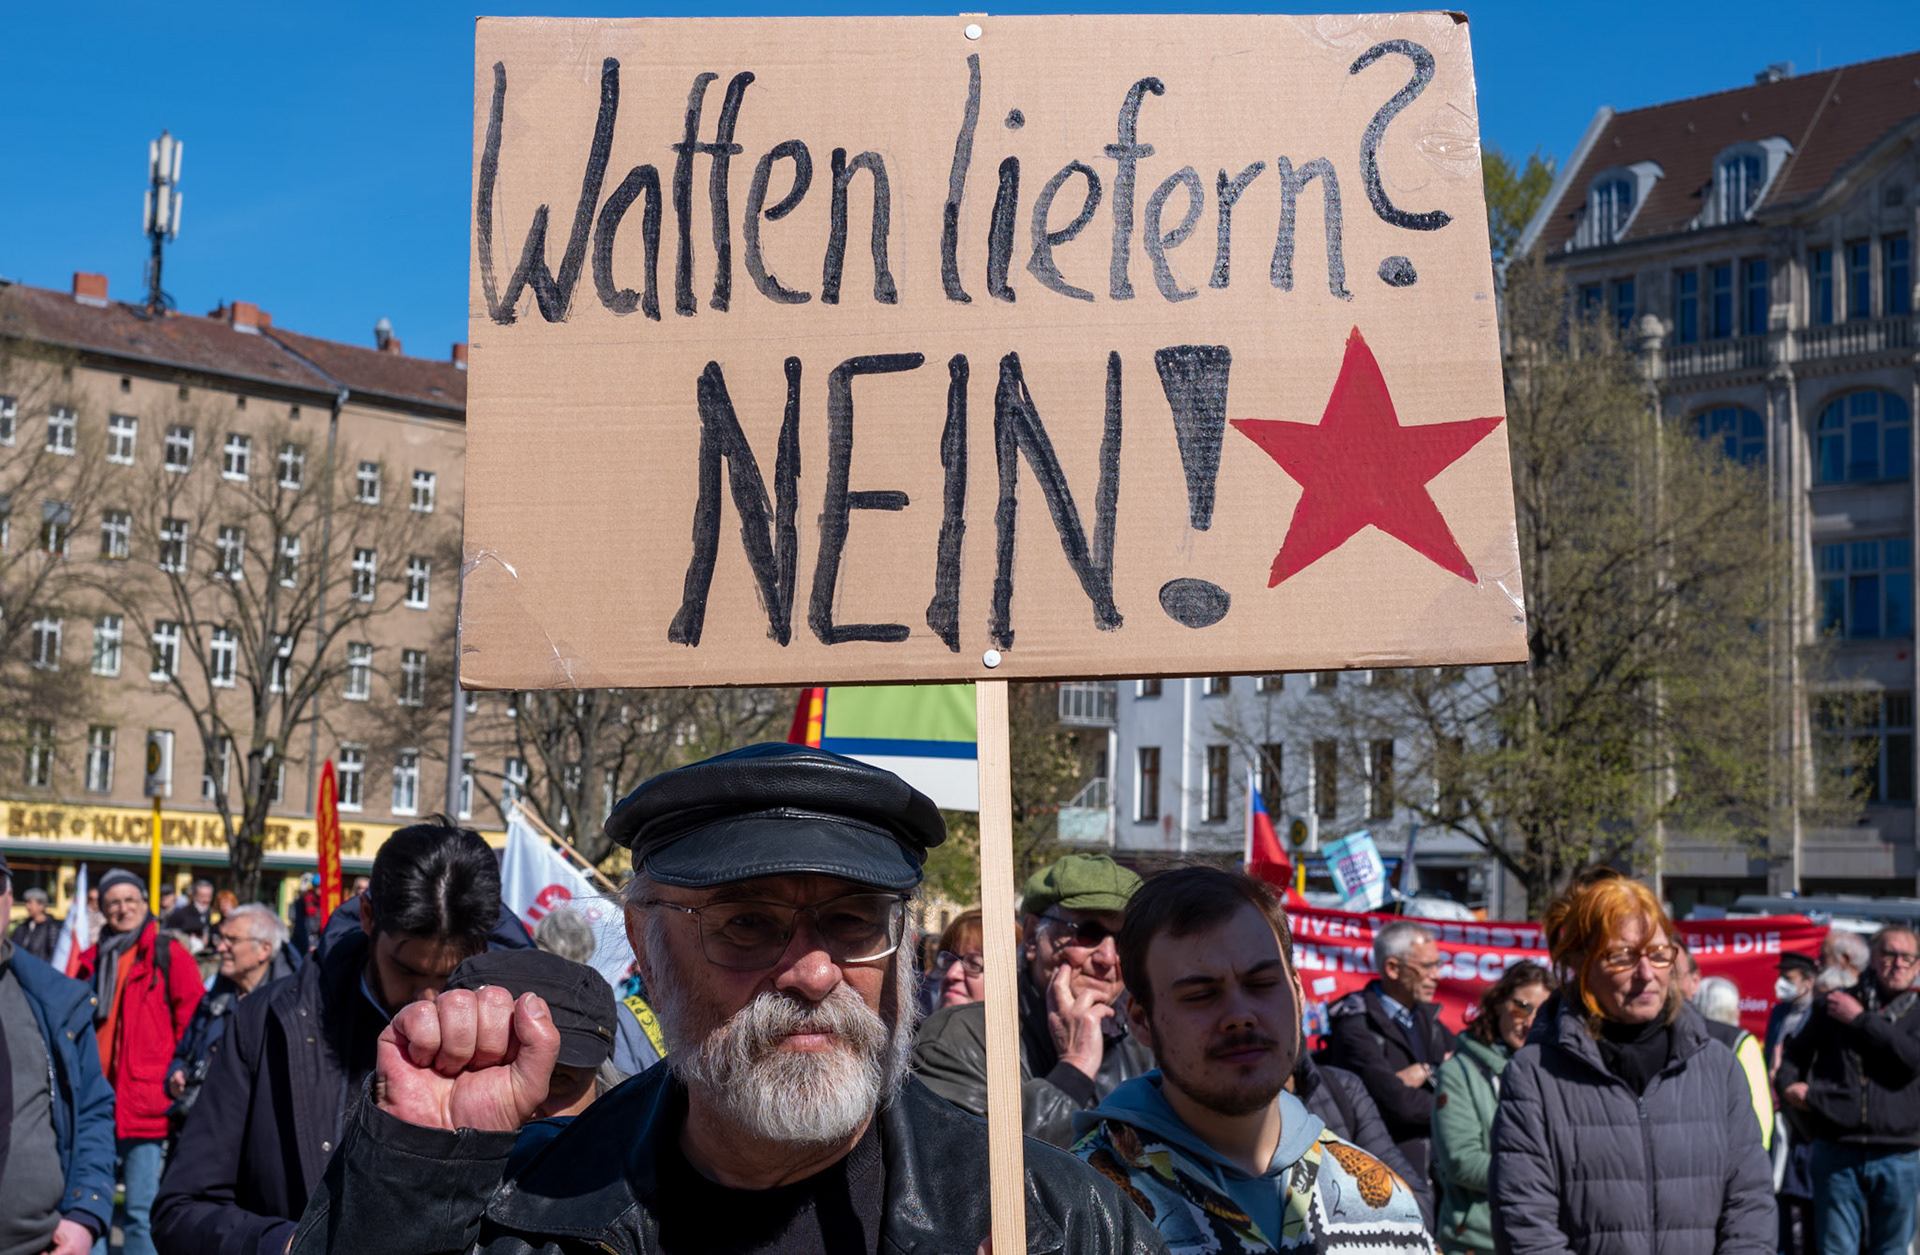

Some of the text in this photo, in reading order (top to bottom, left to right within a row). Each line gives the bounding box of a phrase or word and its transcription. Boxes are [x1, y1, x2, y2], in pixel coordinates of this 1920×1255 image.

[477, 39, 1453, 325] Waffen liefern?
[667, 344, 1232, 652] NEIN!
[1287, 913, 1361, 938] TIVER
[1733, 931, 1781, 954] DIE
